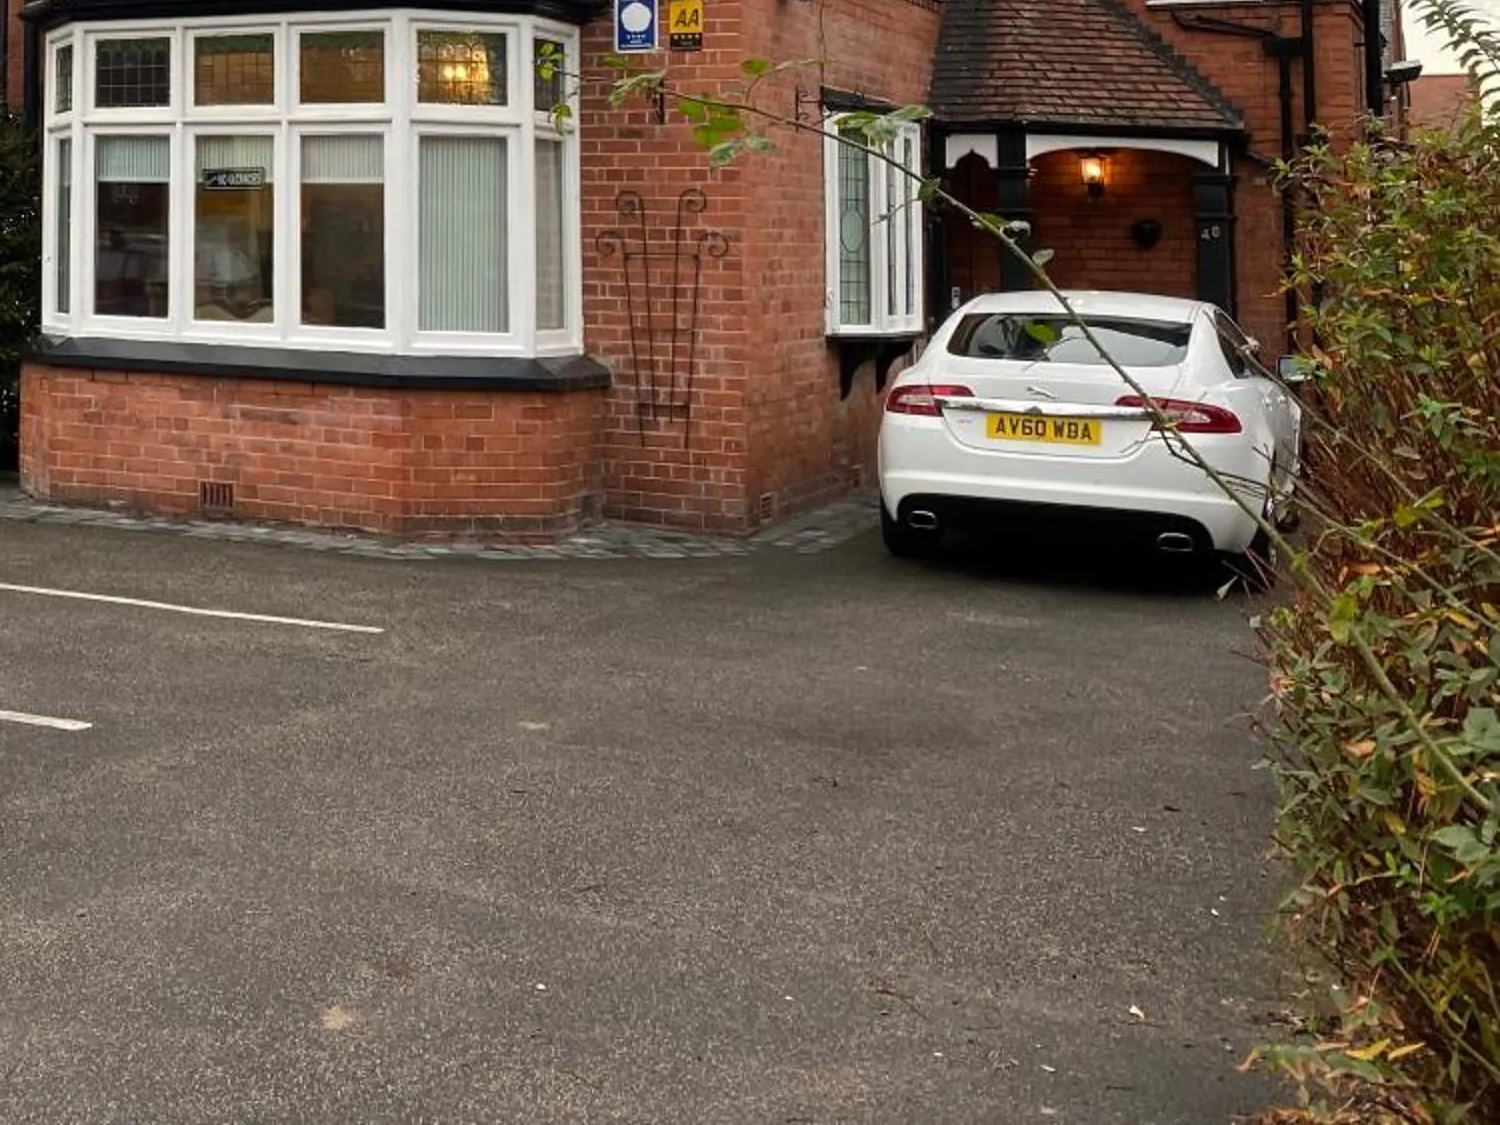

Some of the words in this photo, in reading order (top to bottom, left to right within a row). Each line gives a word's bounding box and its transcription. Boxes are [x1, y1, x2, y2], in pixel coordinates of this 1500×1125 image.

[674, 8, 700, 28] AA
[995, 417, 1047, 437] AY60
[1053, 419, 1093, 441] WBA
